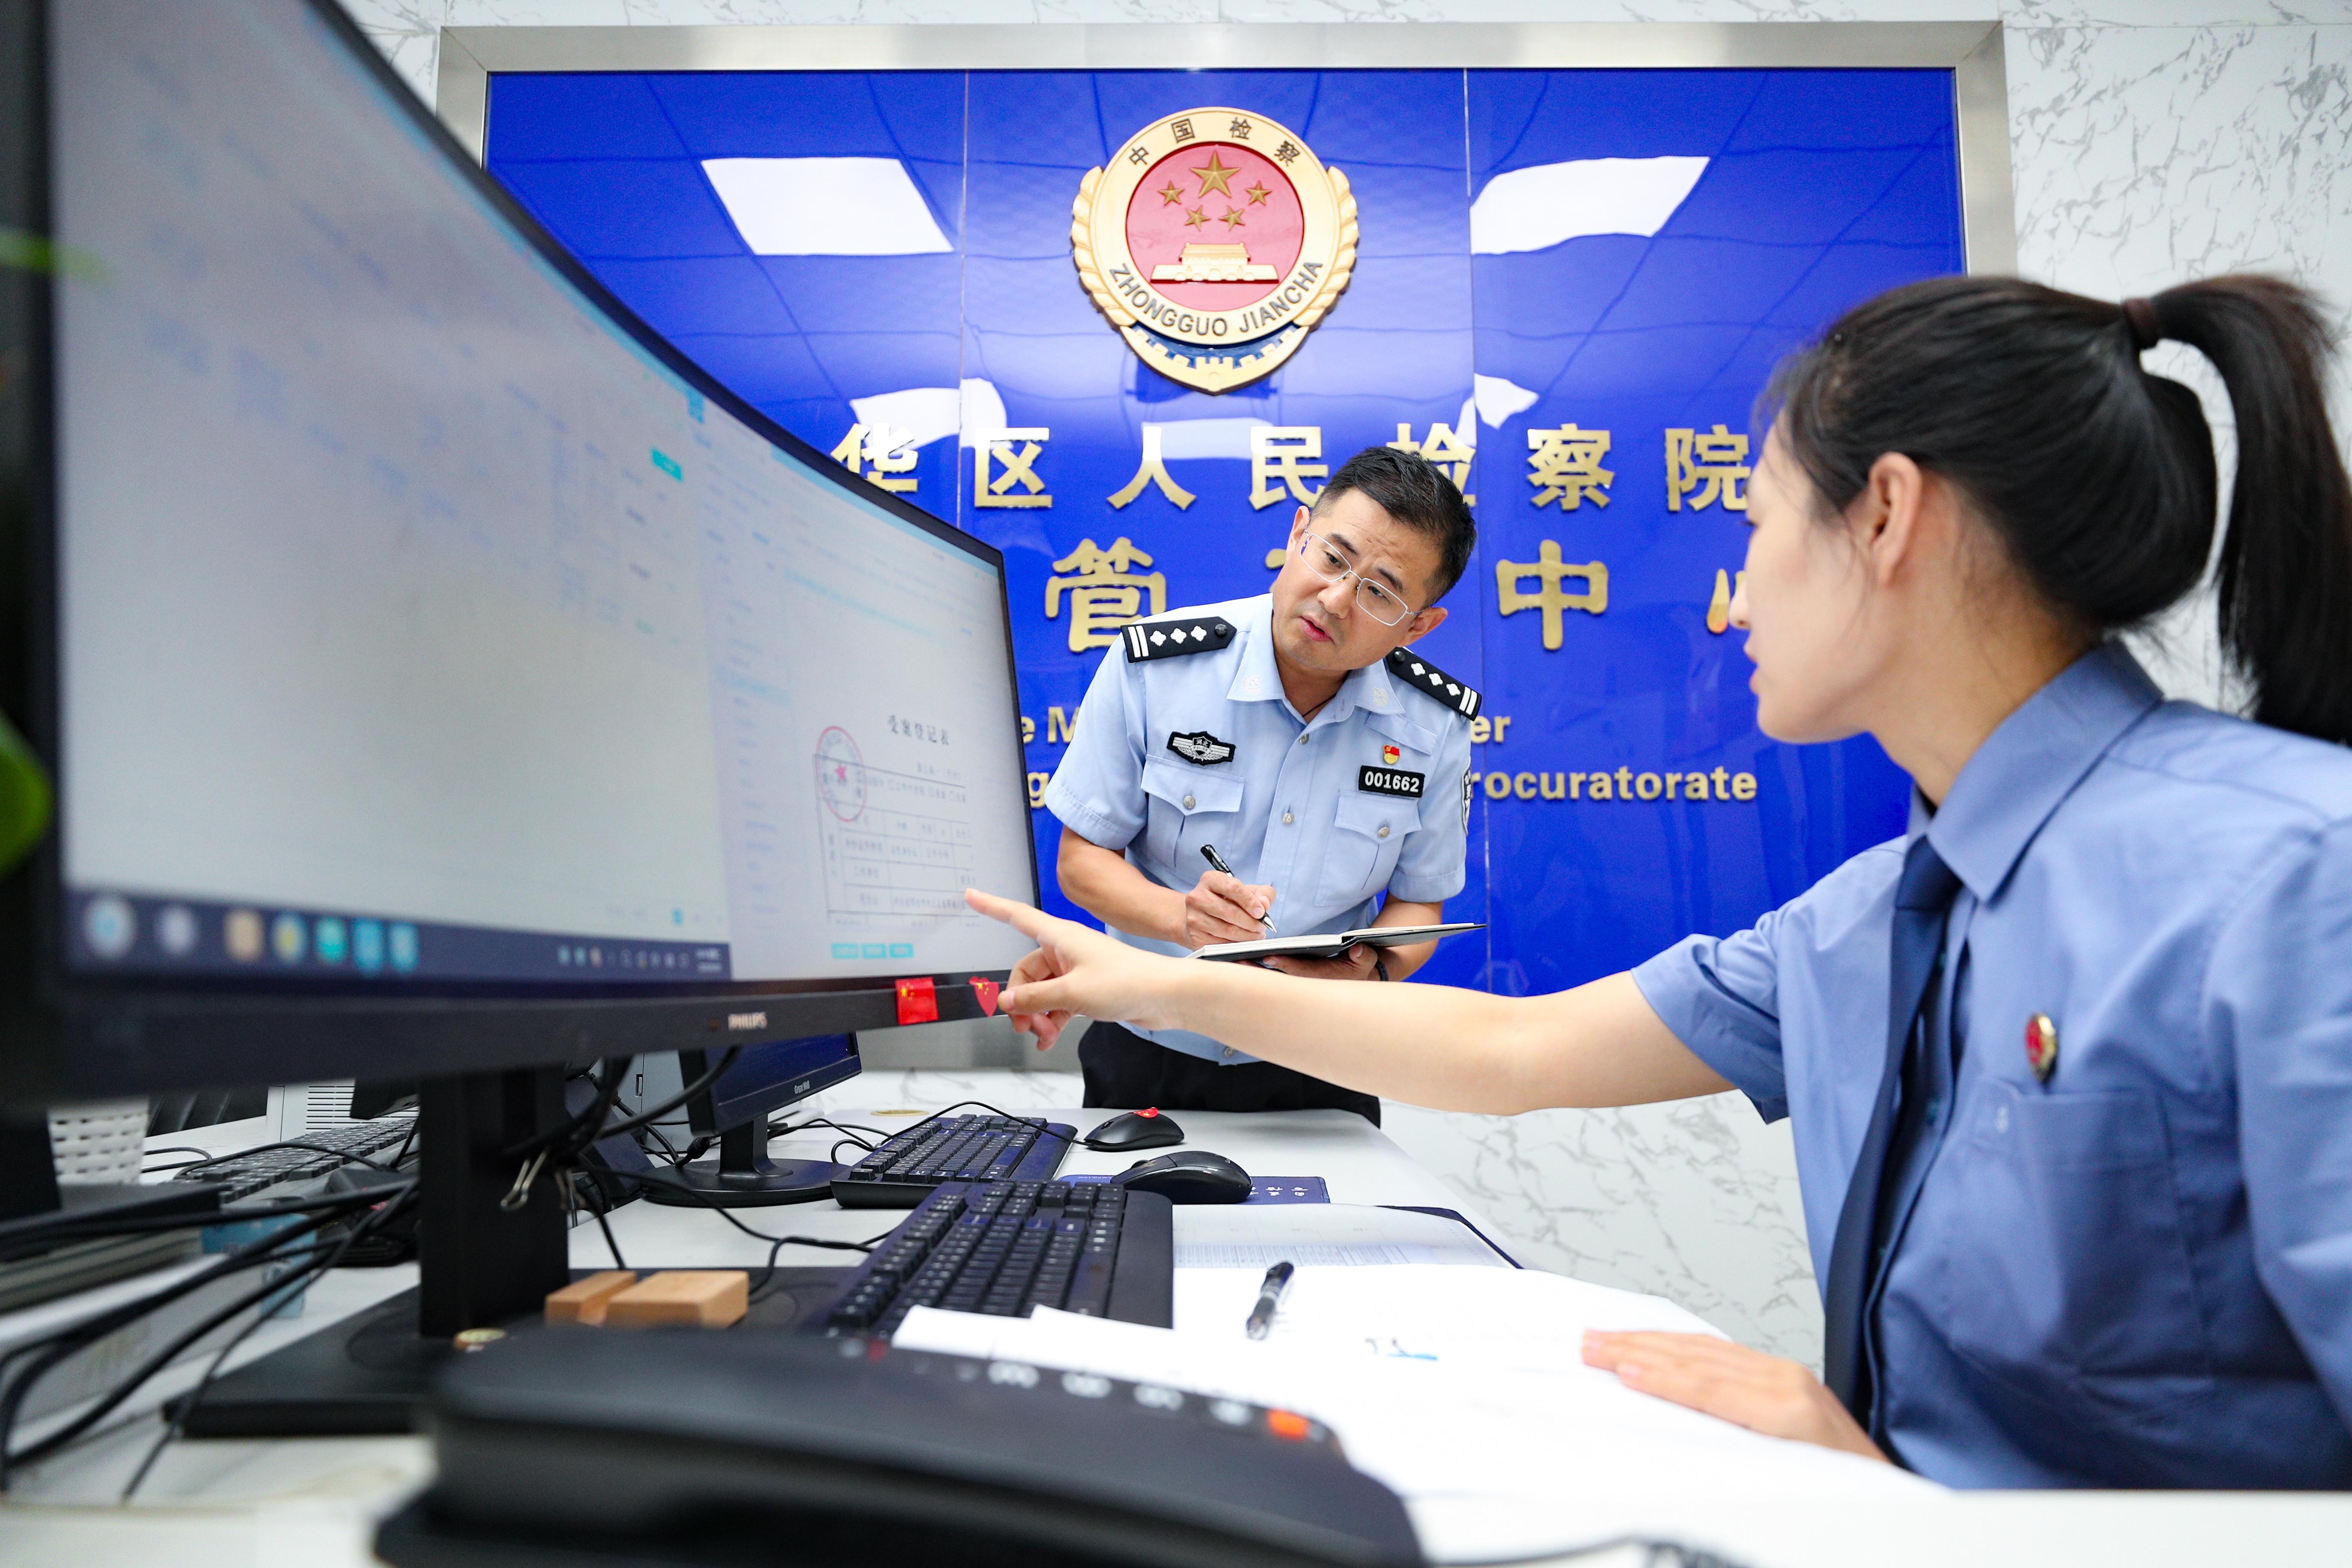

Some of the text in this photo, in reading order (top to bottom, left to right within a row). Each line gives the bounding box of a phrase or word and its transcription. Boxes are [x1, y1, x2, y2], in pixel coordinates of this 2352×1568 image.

[1128, 116, 1301, 166] 中国检察
[1109, 262, 1323, 336] ZHONGGUO JIANCHA
[1196, 738, 1209, 747] 河北
[1364, 771, 1420, 793] 001662
